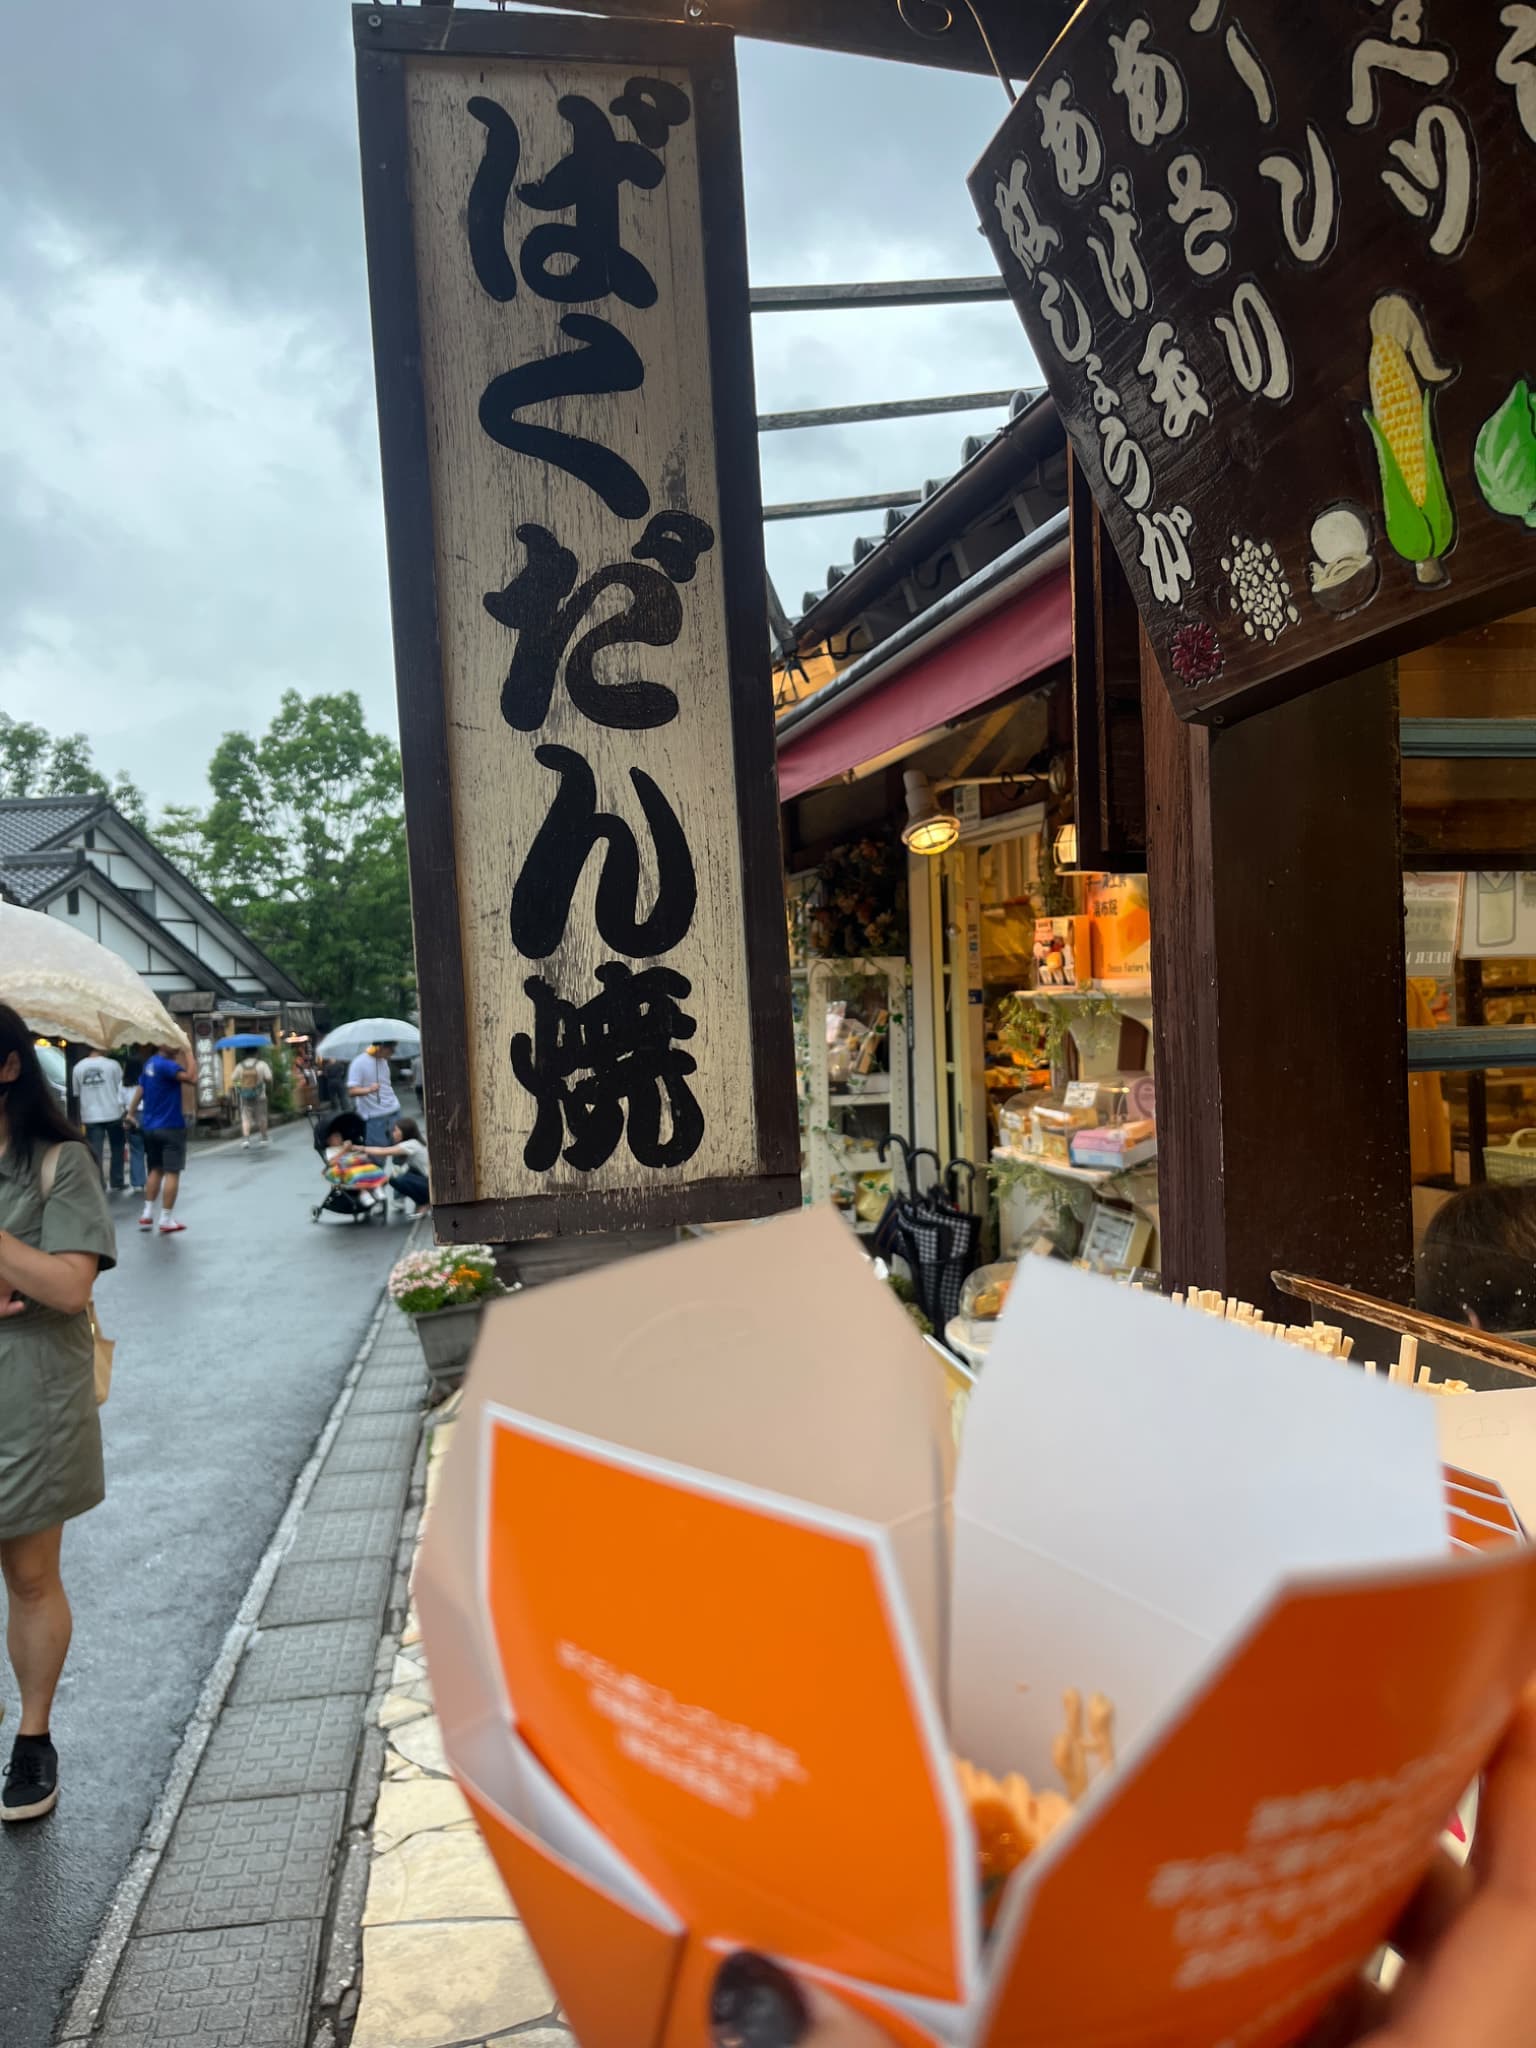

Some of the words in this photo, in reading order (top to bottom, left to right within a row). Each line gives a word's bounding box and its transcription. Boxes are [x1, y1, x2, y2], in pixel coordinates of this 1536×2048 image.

[1109, 19, 1292, 398] あさり
[467, 77, 714, 1173] ばくだん焼
